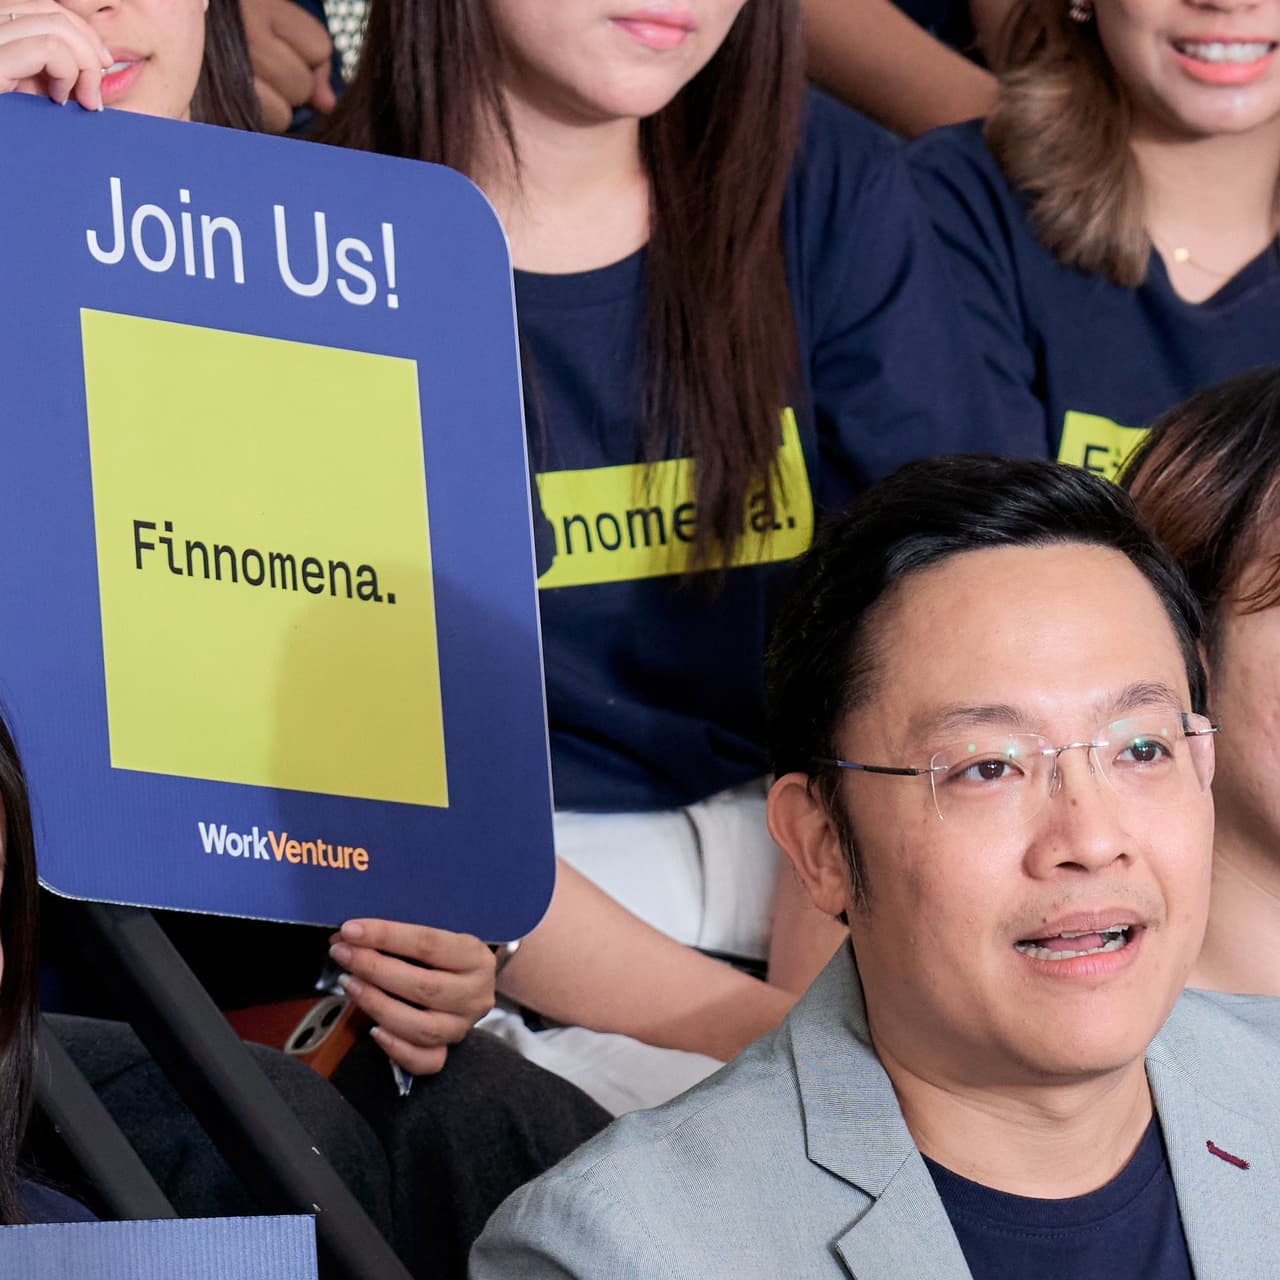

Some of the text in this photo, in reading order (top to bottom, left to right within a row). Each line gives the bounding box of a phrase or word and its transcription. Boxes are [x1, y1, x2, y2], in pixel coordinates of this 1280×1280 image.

[85, 176, 400, 310] Join Us!
[132, 518, 398, 605] Finnomena.
[197, 821, 370, 872] WorkVenture
